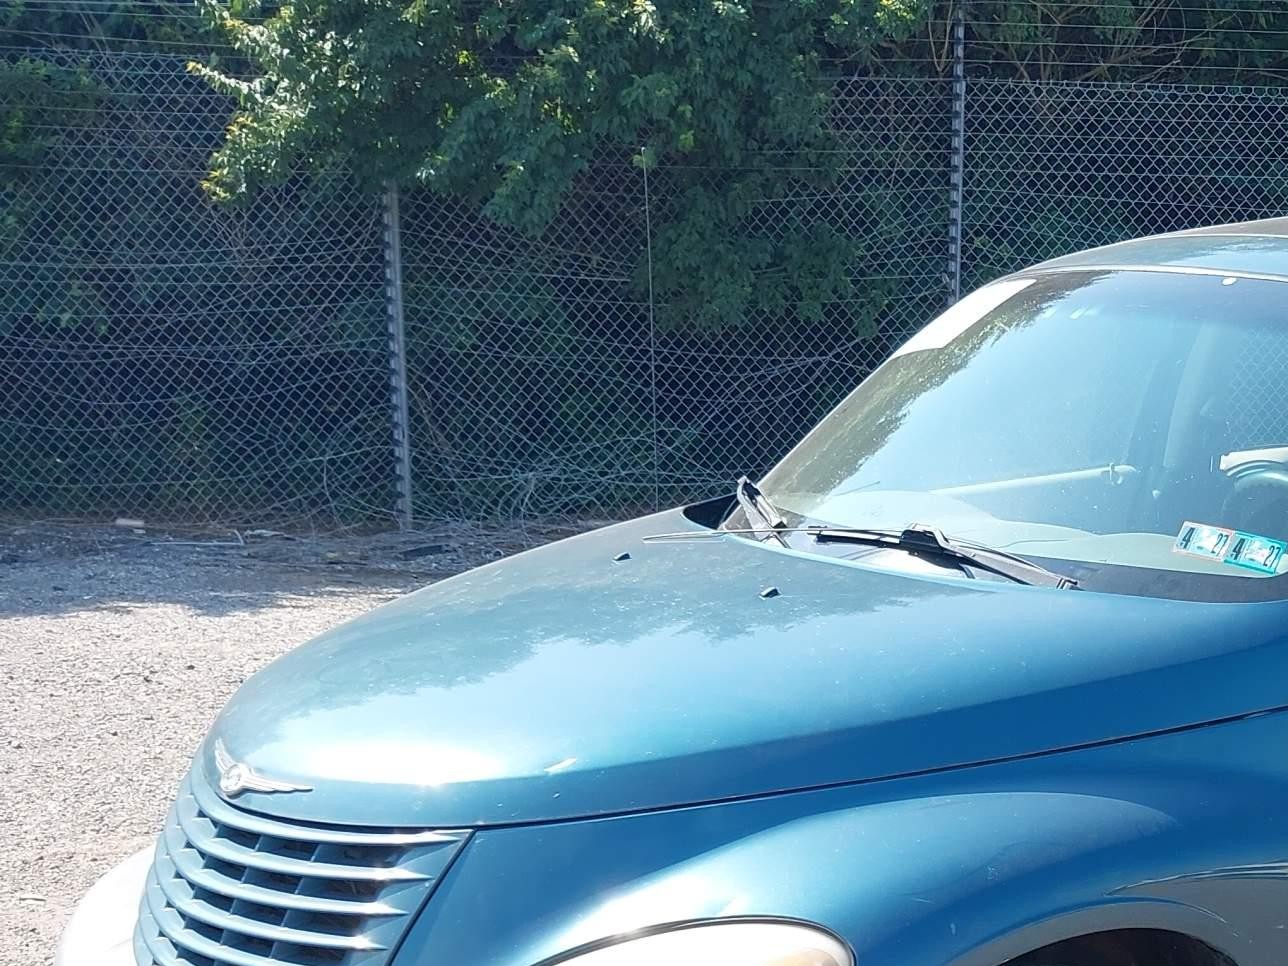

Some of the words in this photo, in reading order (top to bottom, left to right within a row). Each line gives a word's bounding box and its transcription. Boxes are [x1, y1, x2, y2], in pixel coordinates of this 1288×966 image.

[1180, 527, 1195, 549] 4
[1230, 538, 1245, 560] 4
[1263, 545, 1281, 568] 27
